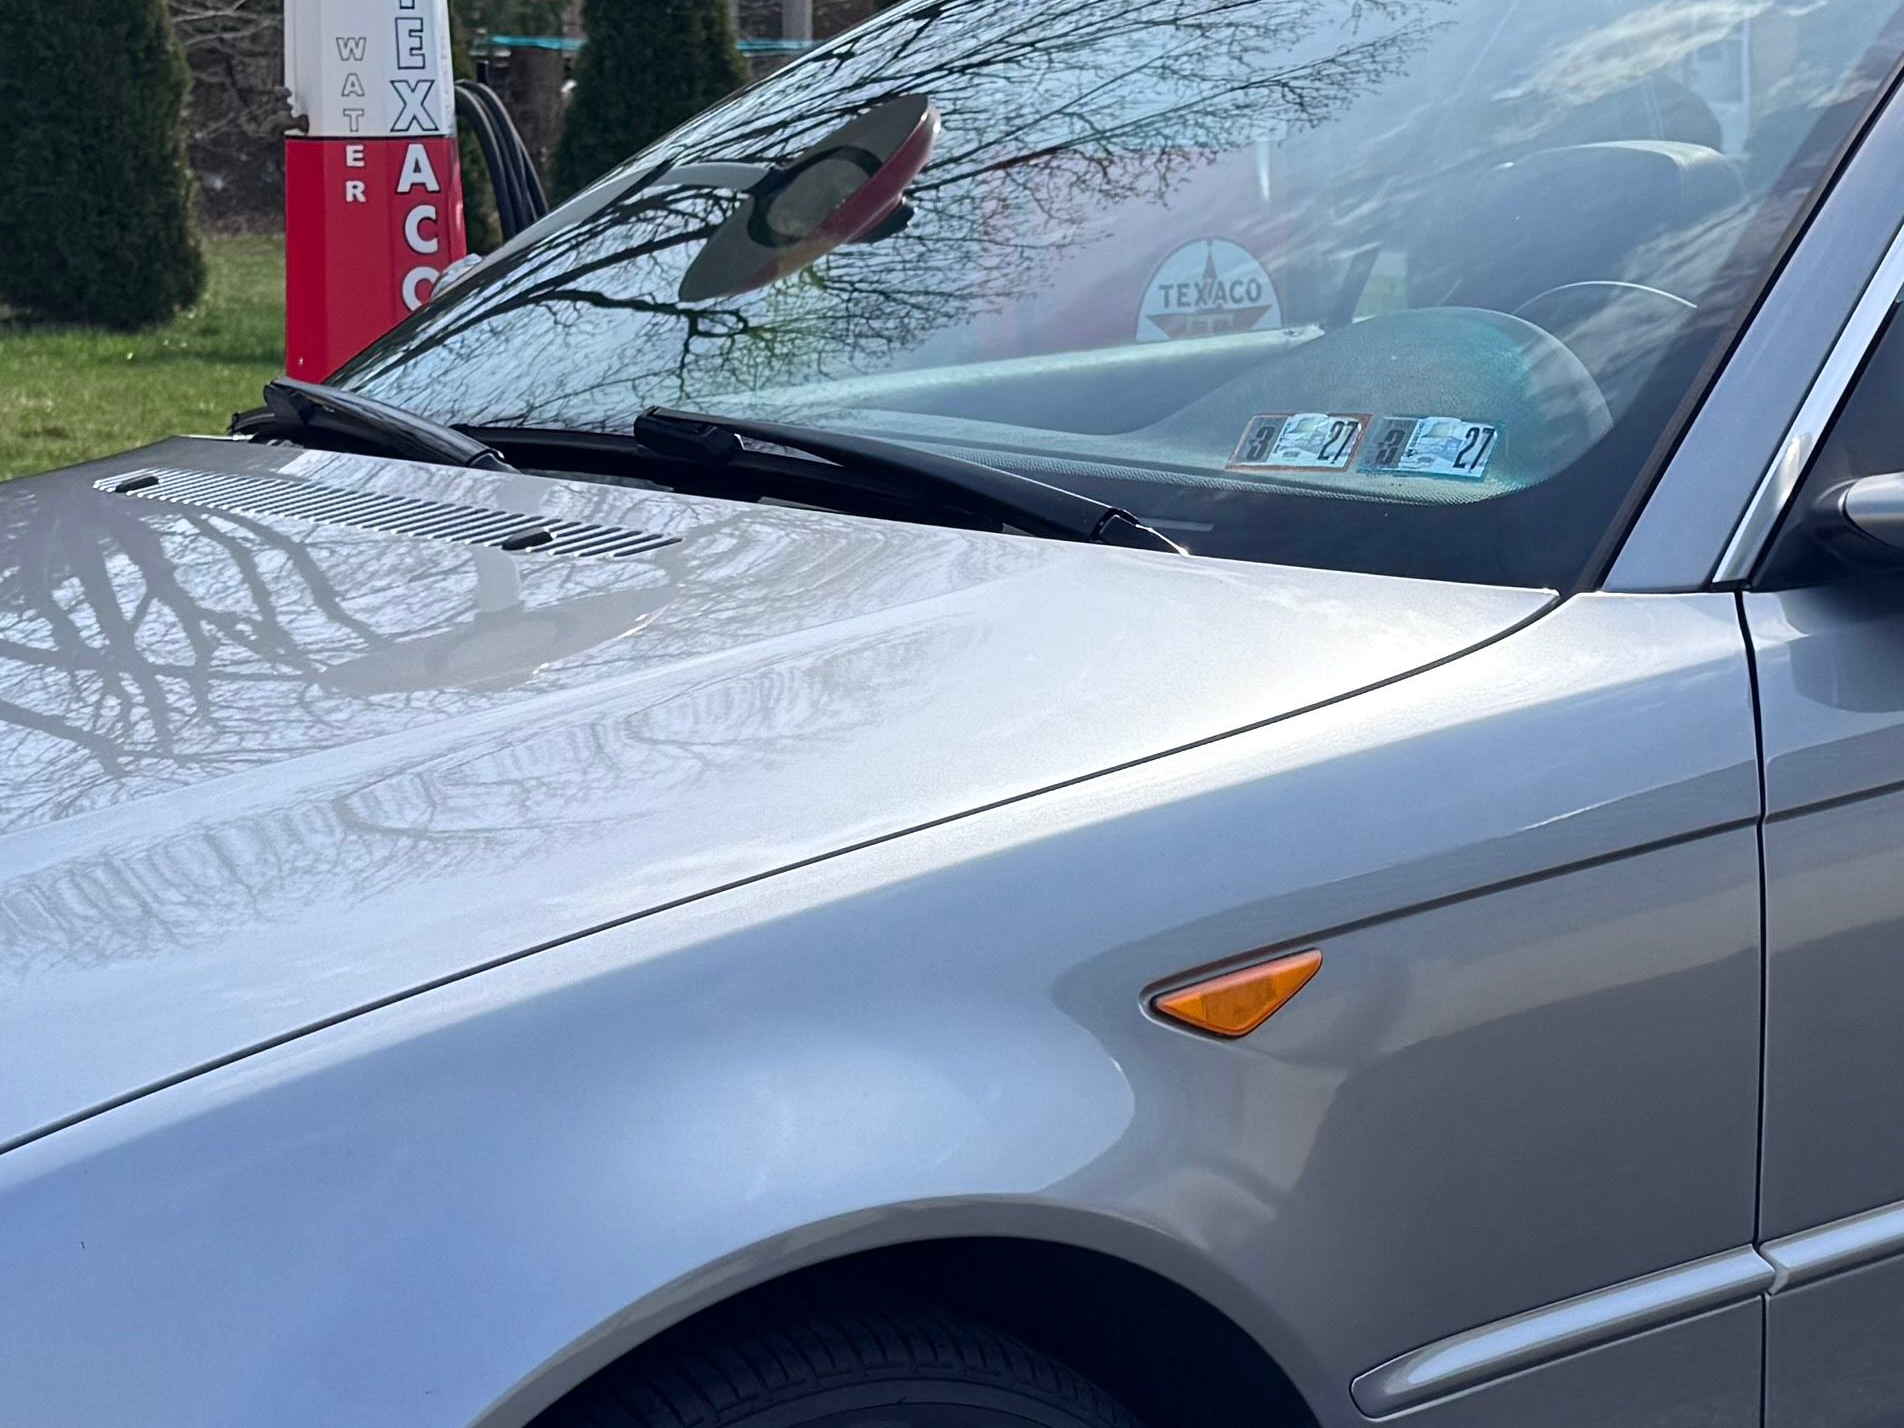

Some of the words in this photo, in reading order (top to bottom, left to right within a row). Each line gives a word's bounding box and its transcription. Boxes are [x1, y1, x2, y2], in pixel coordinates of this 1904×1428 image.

[336, 37, 367, 203] WATER
[1159, 277, 1262, 308] TEXACO
[1247, 426, 1275, 462] 3
[1317, 420, 1359, 464] 27
[1376, 429, 1405, 465] 3
[1452, 427, 1496, 472] 27
